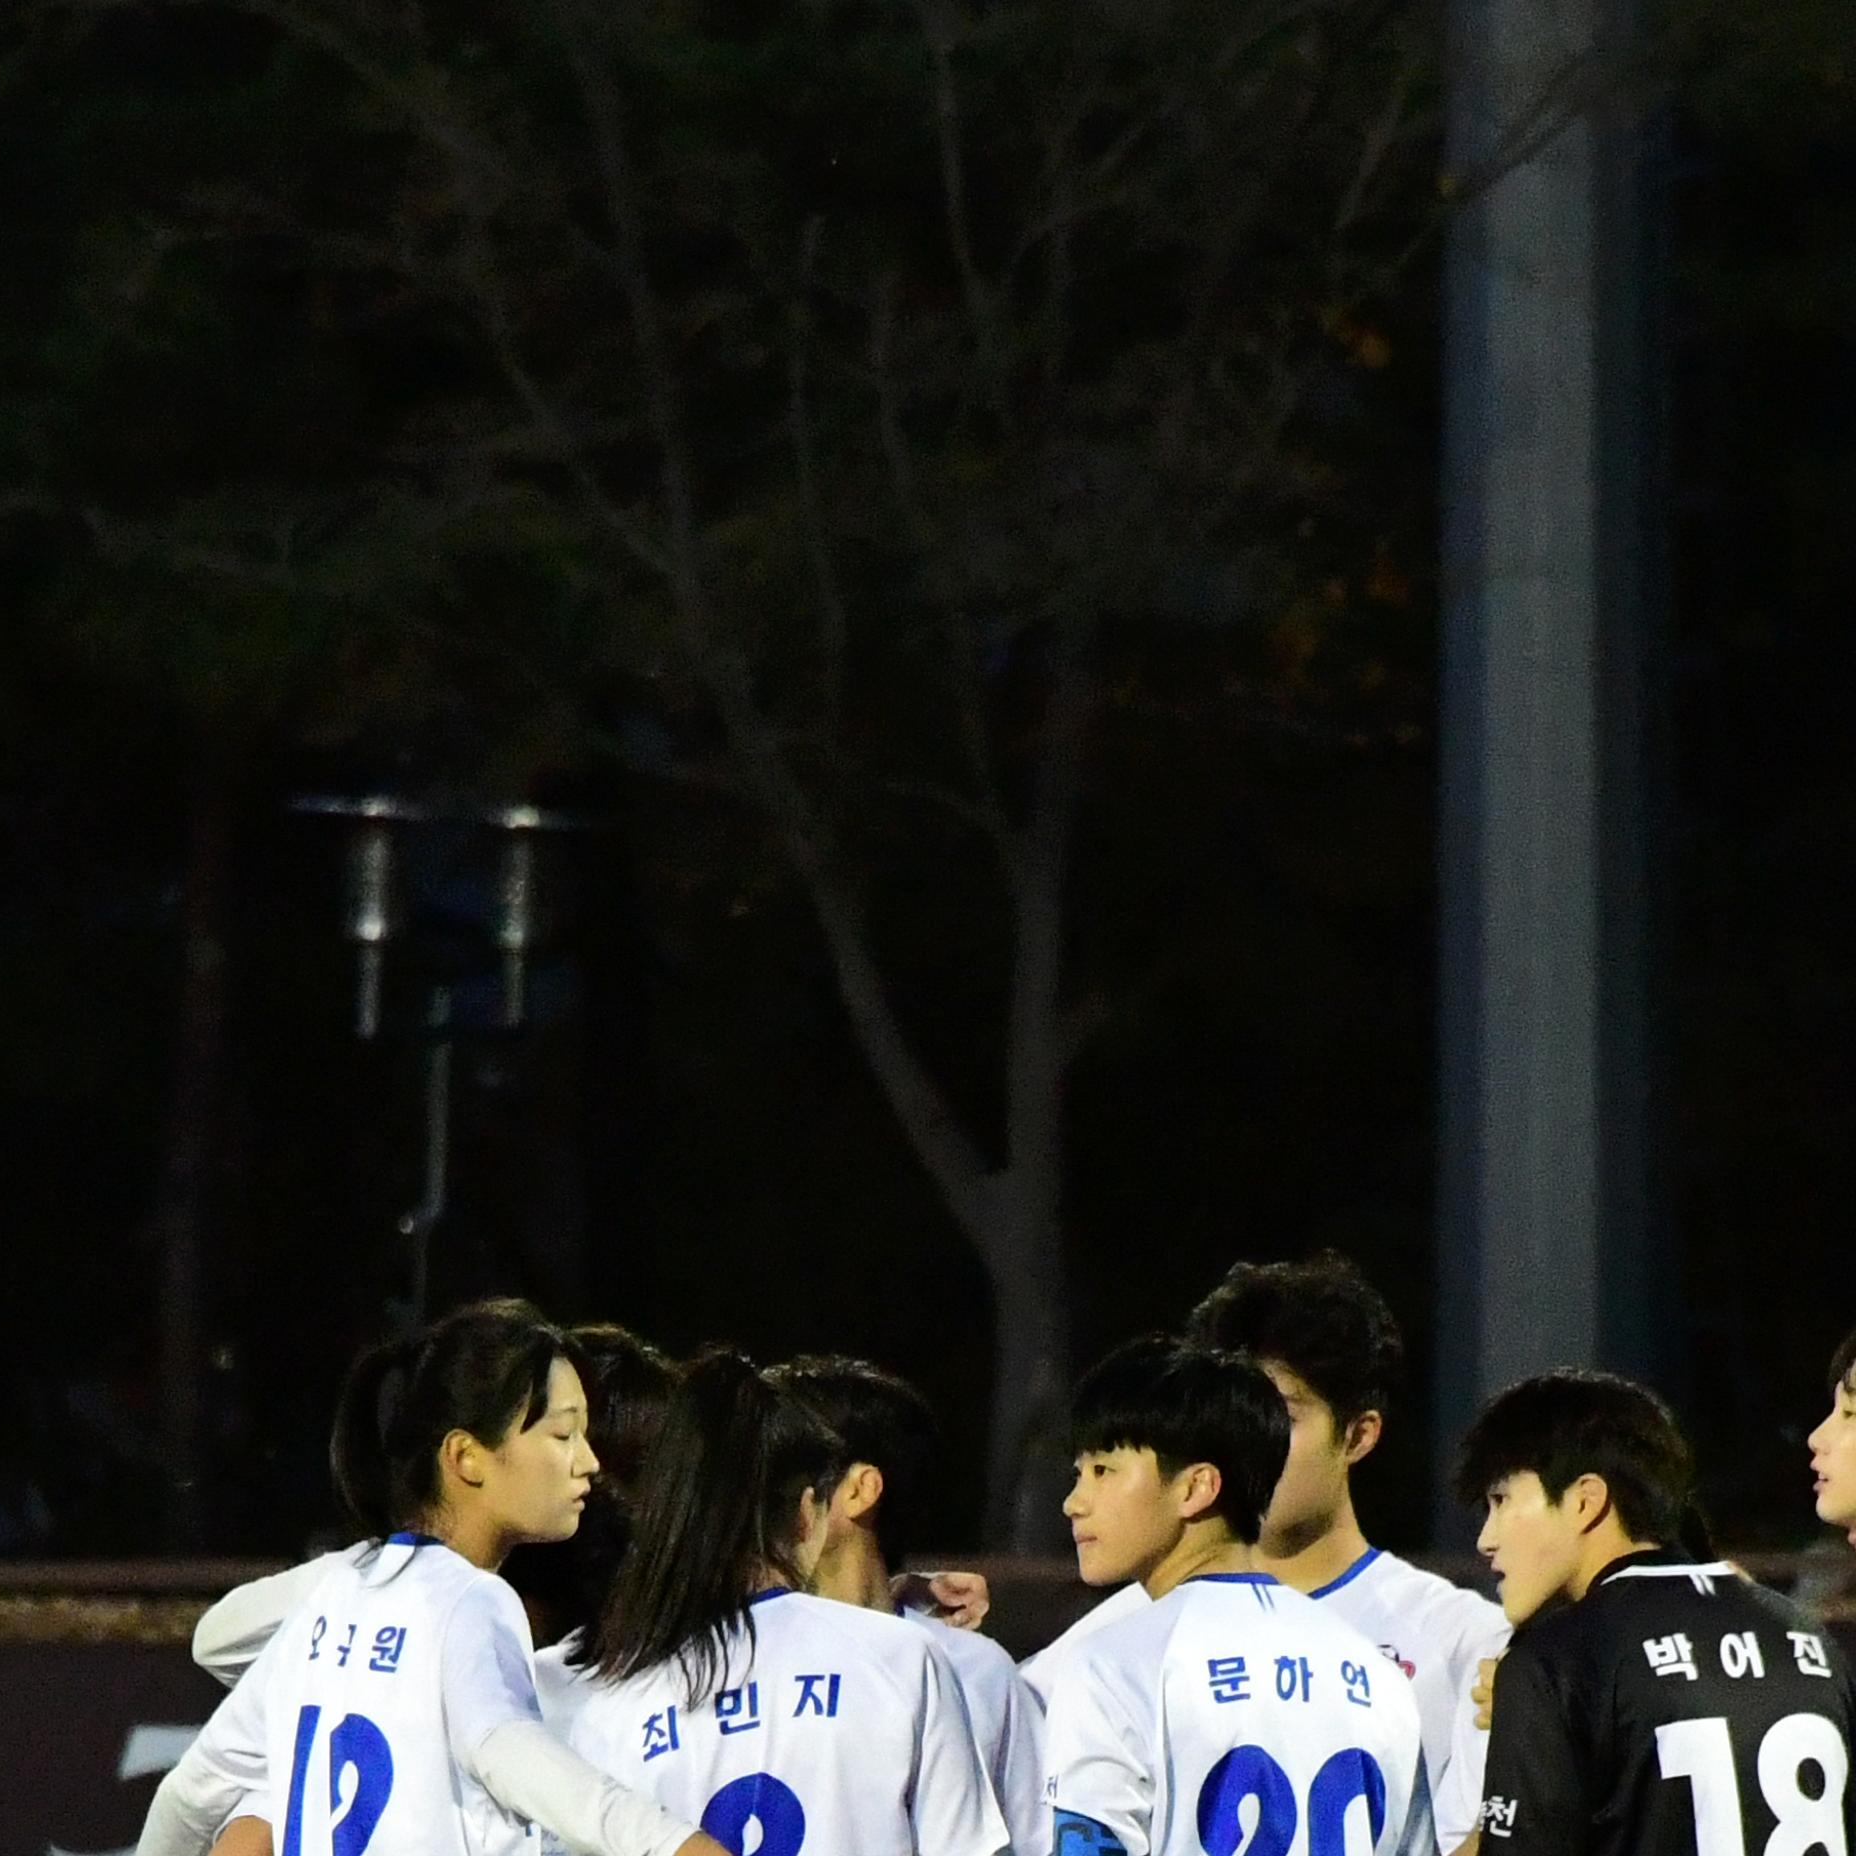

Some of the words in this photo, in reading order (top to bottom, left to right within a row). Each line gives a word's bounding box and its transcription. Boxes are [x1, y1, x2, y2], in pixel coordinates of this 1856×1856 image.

[1207, 1654, 1372, 1709] 문하연
[1642, 1630, 1832, 1682] 박어진
[641, 1672, 842, 1763] 최민지
[1481, 1795, 1518, 1838] 천
